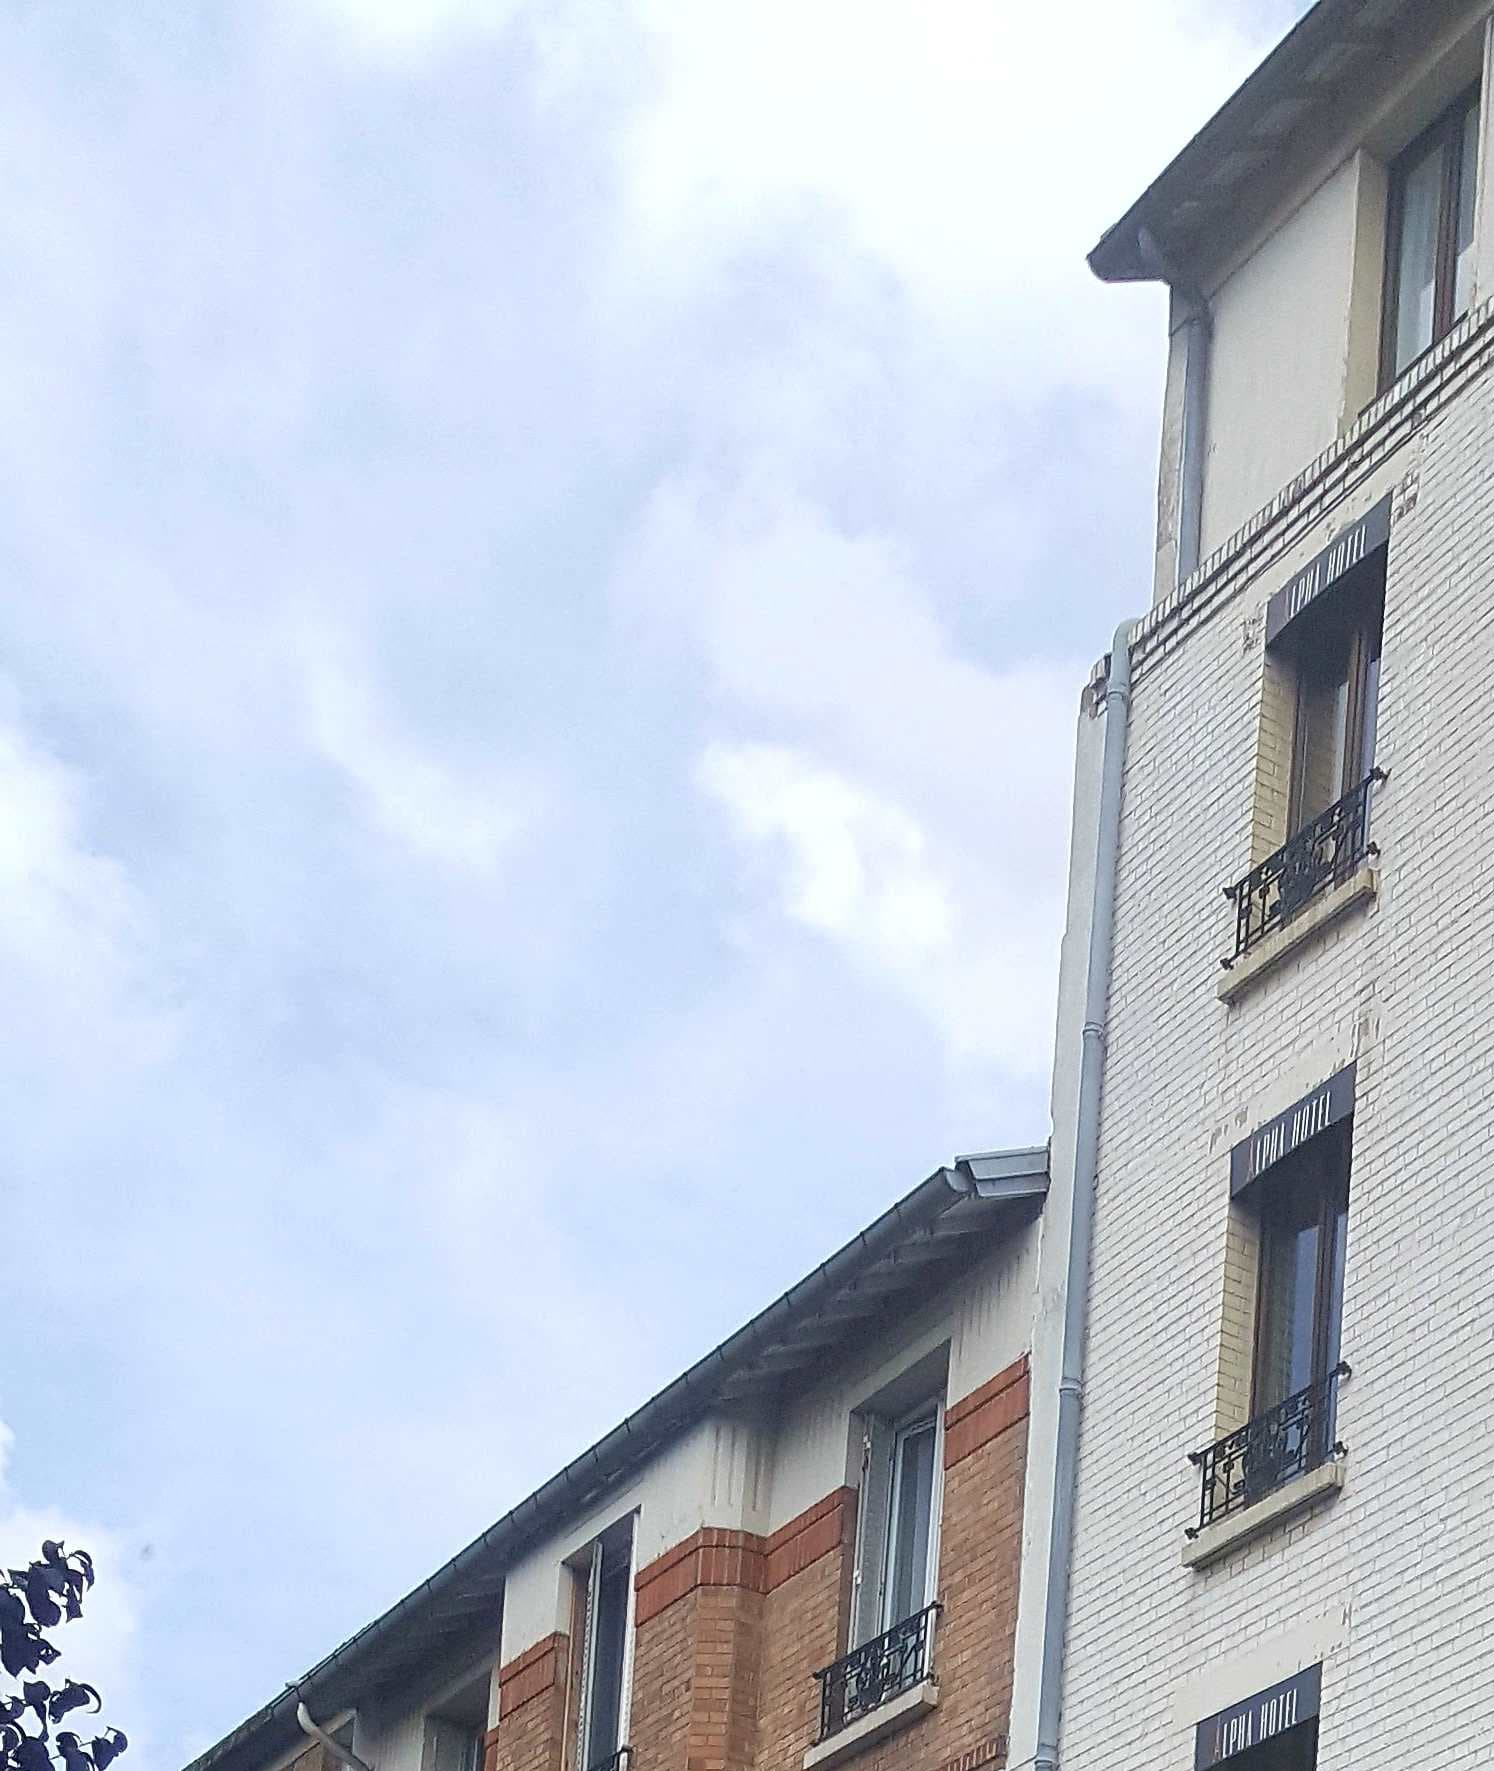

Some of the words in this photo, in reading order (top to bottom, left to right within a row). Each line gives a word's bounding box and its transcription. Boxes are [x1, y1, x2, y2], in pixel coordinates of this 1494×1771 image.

[1327, 524, 1367, 585] HOTEL
[1291, 1091, 1331, 1149] HOTEL
[1259, 1688, 1298, 1741] HOTEL
